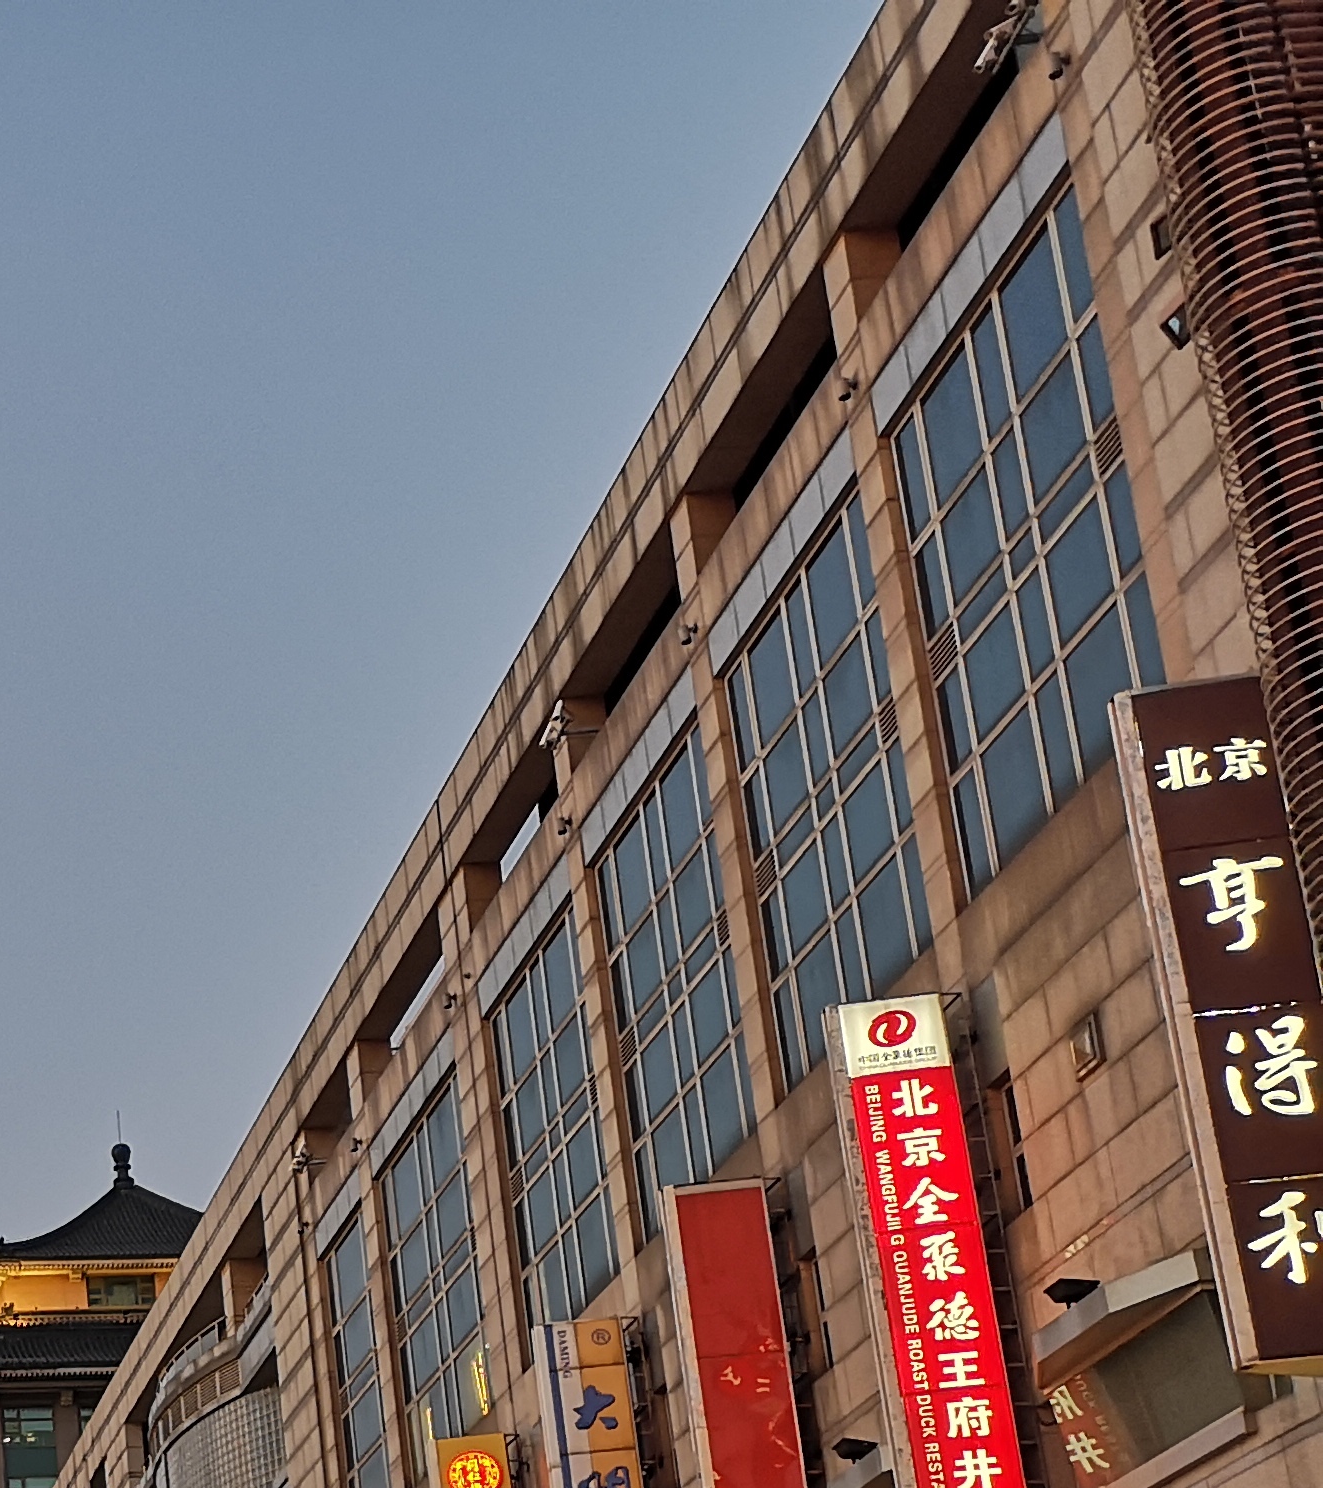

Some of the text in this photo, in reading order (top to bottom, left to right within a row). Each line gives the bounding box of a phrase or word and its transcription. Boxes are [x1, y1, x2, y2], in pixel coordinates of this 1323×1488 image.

[1155, 737, 1268, 791] 北京
[1179, 855, 1323, 1285] 亨得利
[864, 1084, 887, 1143] BEIJING
[893, 1250, 920, 1334] QUANJUDE
[557, 1329, 573, 1379] DAMING
[907, 1338, 929, 1391] ROAST
[916, 1394, 936, 1438] DUCK
